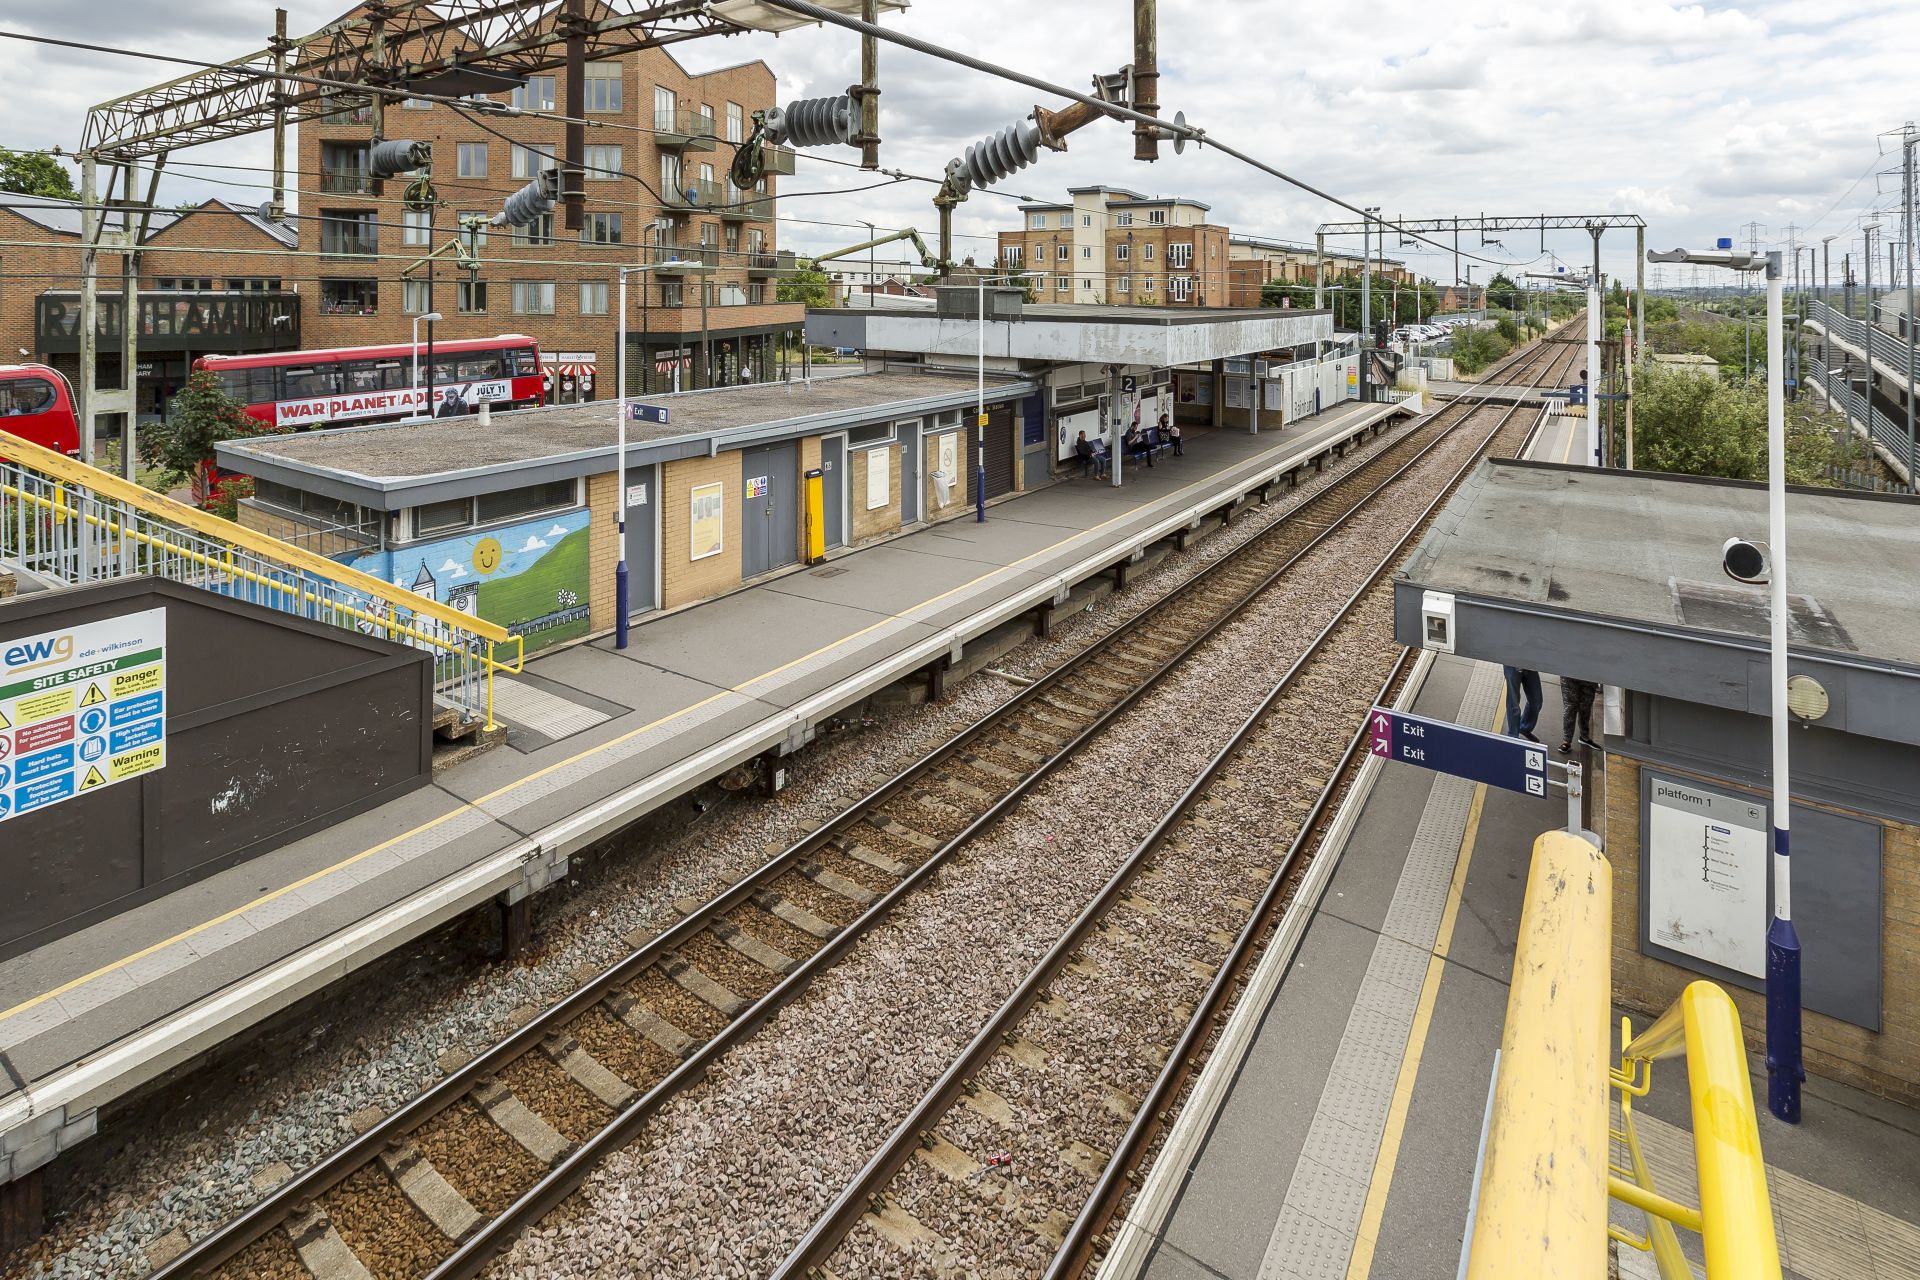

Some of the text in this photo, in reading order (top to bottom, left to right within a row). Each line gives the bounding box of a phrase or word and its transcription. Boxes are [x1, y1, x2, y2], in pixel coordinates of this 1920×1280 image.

[476, 386, 494, 396] JULY
[1125, 379, 1133, 391] 2
[280, 402, 326, 418] WAR
[330, 396, 396, 417] PLANET
[634, 407, 644, 416] Exit
[4, 636, 74, 675] ewg
[80, 638, 142, 658] ede wilkinson
[33, 660, 118, 690] SITE SAFETY
[116, 668, 158, 686] Danger
[33, 720, 69, 734] admittance
[116, 730, 130, 738] High
[1403, 722, 1424, 738] Exit
[29, 734, 62, 748] personnel
[115, 742, 131, 750] must
[28, 753, 62, 768] Hard hats
[113, 748, 160, 767] Warning
[1403, 746, 1425, 760] Exit
[21, 767, 39, 777] must
[51, 758, 69, 767] worn
[27, 778, 63, 793] Protective
[29, 786, 60, 799] footwear
[21, 799, 39, 809] must
[51, 790, 69, 799] worn
[1658, 787, 1712, 807] platform 1
